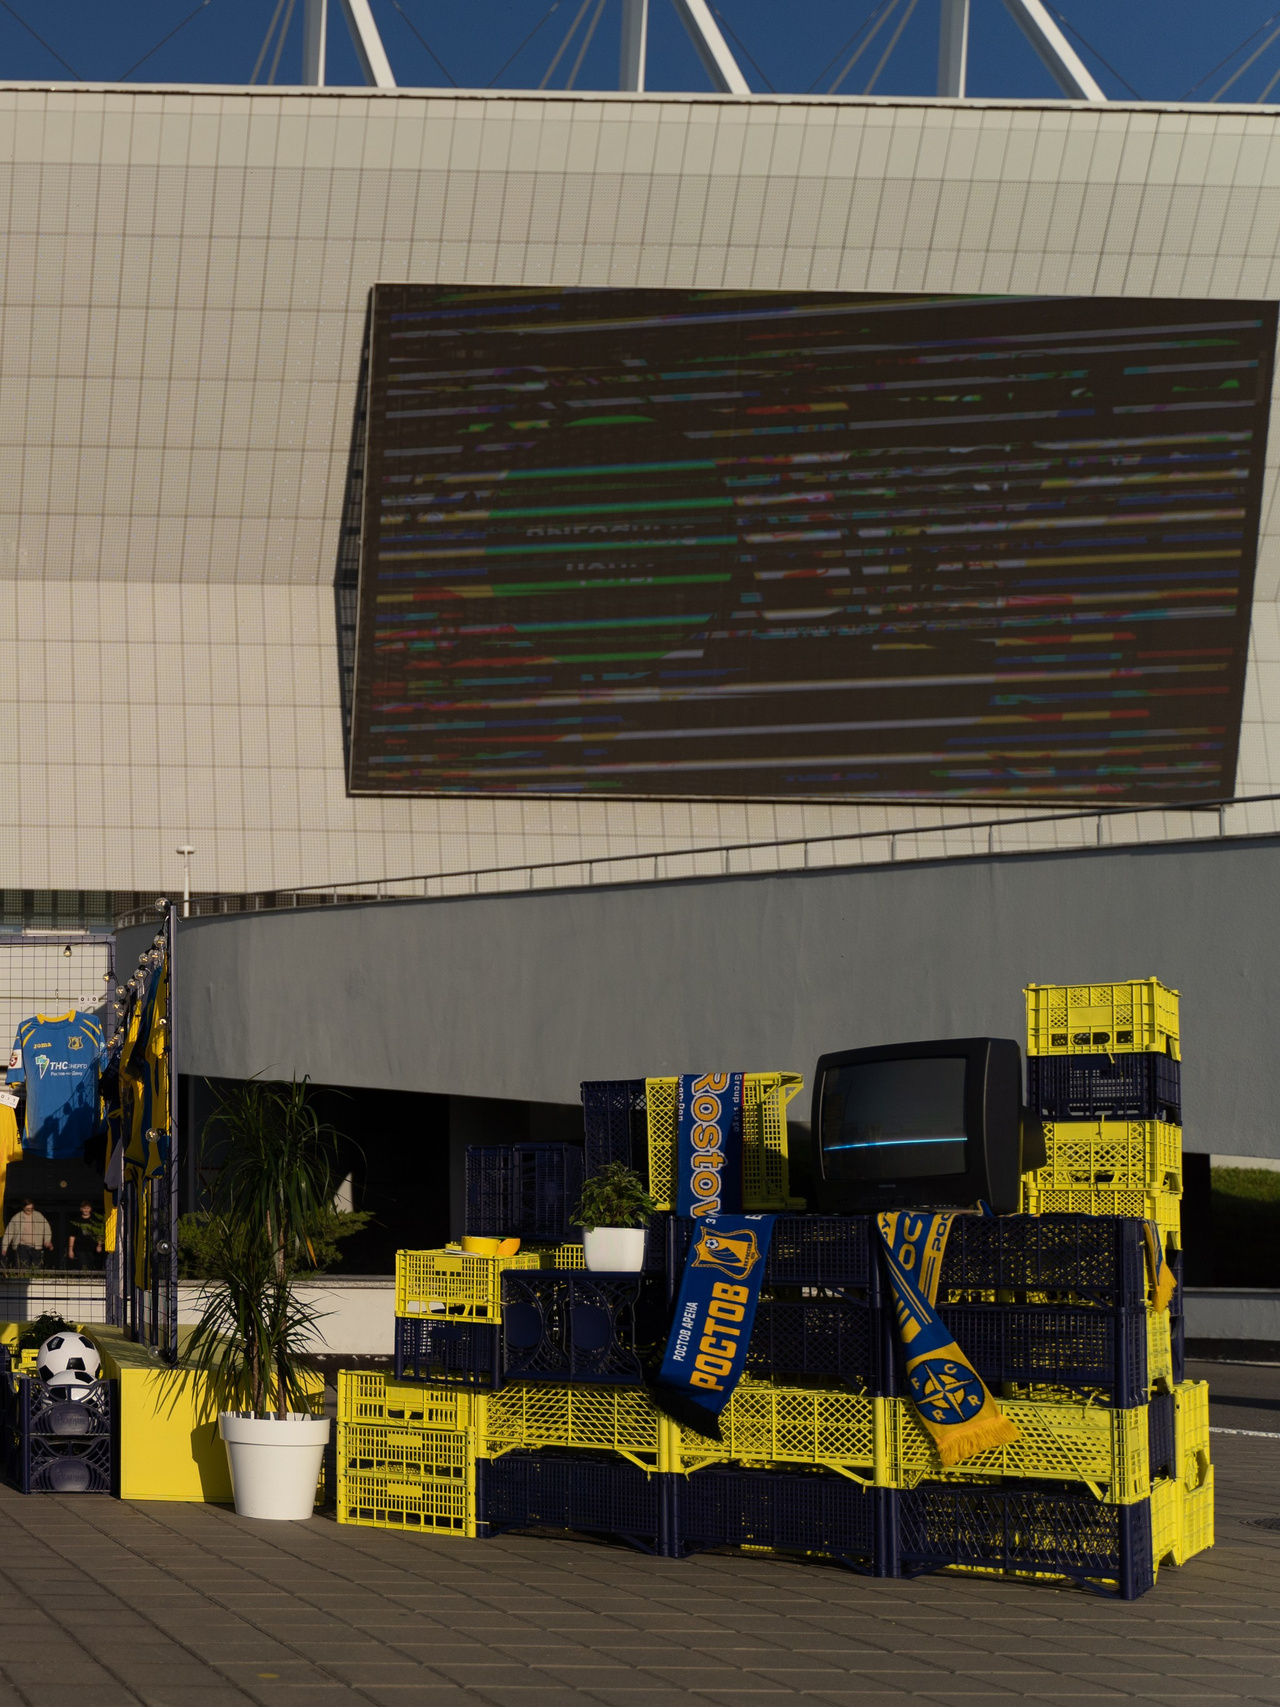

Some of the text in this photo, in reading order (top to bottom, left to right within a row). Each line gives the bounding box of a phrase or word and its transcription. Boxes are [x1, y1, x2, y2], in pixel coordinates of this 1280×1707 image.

[50, 1061, 68, 1070] ТНС
[732, 1073, 742, 1103] Group
[690, 1072, 730, 1219] Rostov
[673, 1302, 699, 1362] РОСТОВ АРЕНА
[689, 1281, 750, 1391] РОСТОВ
